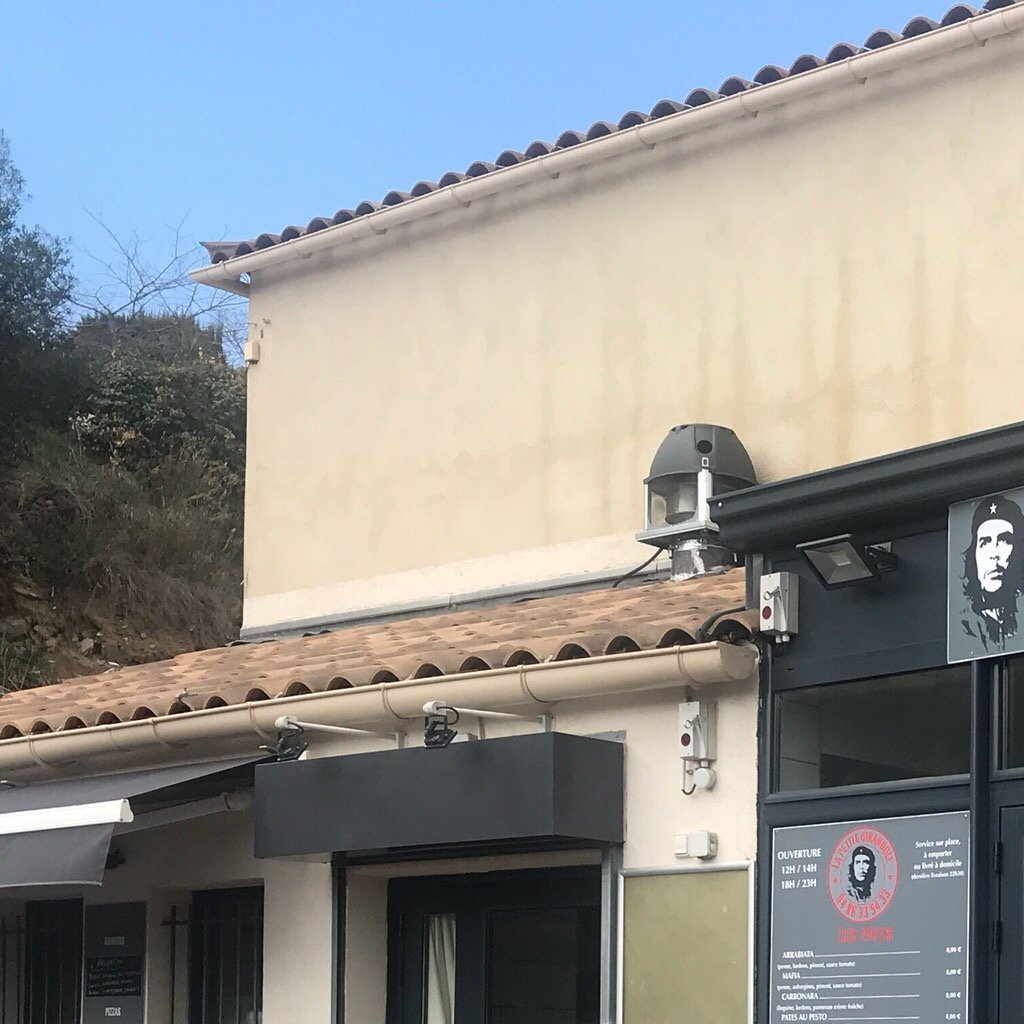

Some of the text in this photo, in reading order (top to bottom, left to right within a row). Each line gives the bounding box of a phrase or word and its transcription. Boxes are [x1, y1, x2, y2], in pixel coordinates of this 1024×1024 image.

[778, 849, 821, 860] OUVERTURE
[781, 864, 817, 874] 12H 14H
[781, 879, 817, 889] 18H 23H
[783, 951, 814, 959] ARRABIATA
[782, 972, 801, 980] MAFIA
[782, 992, 818, 1000] CARBONARA
[809, 1013, 827, 1021] PESTO
